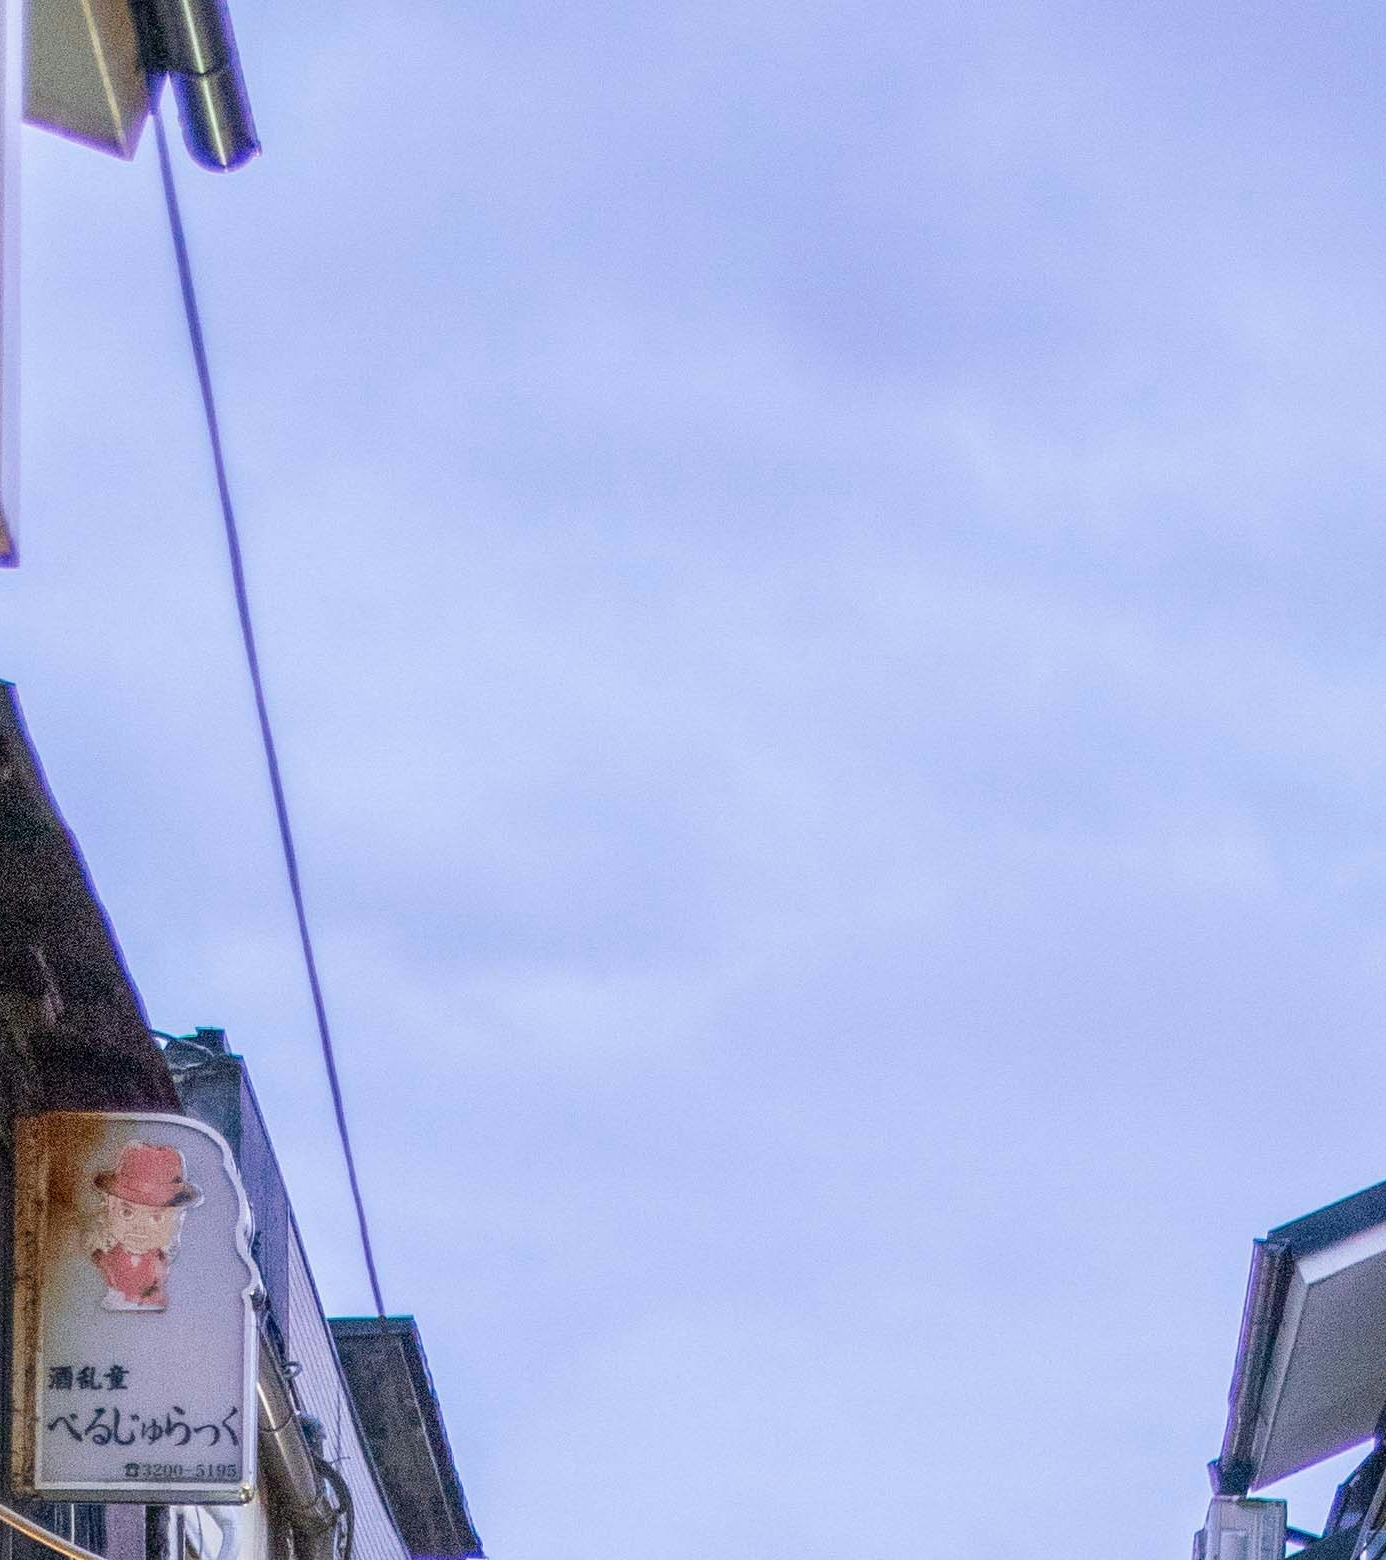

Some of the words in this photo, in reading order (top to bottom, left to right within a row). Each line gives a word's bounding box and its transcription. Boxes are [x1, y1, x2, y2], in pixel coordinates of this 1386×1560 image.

[47, 1405, 239, 1448] べるじゅらっく
